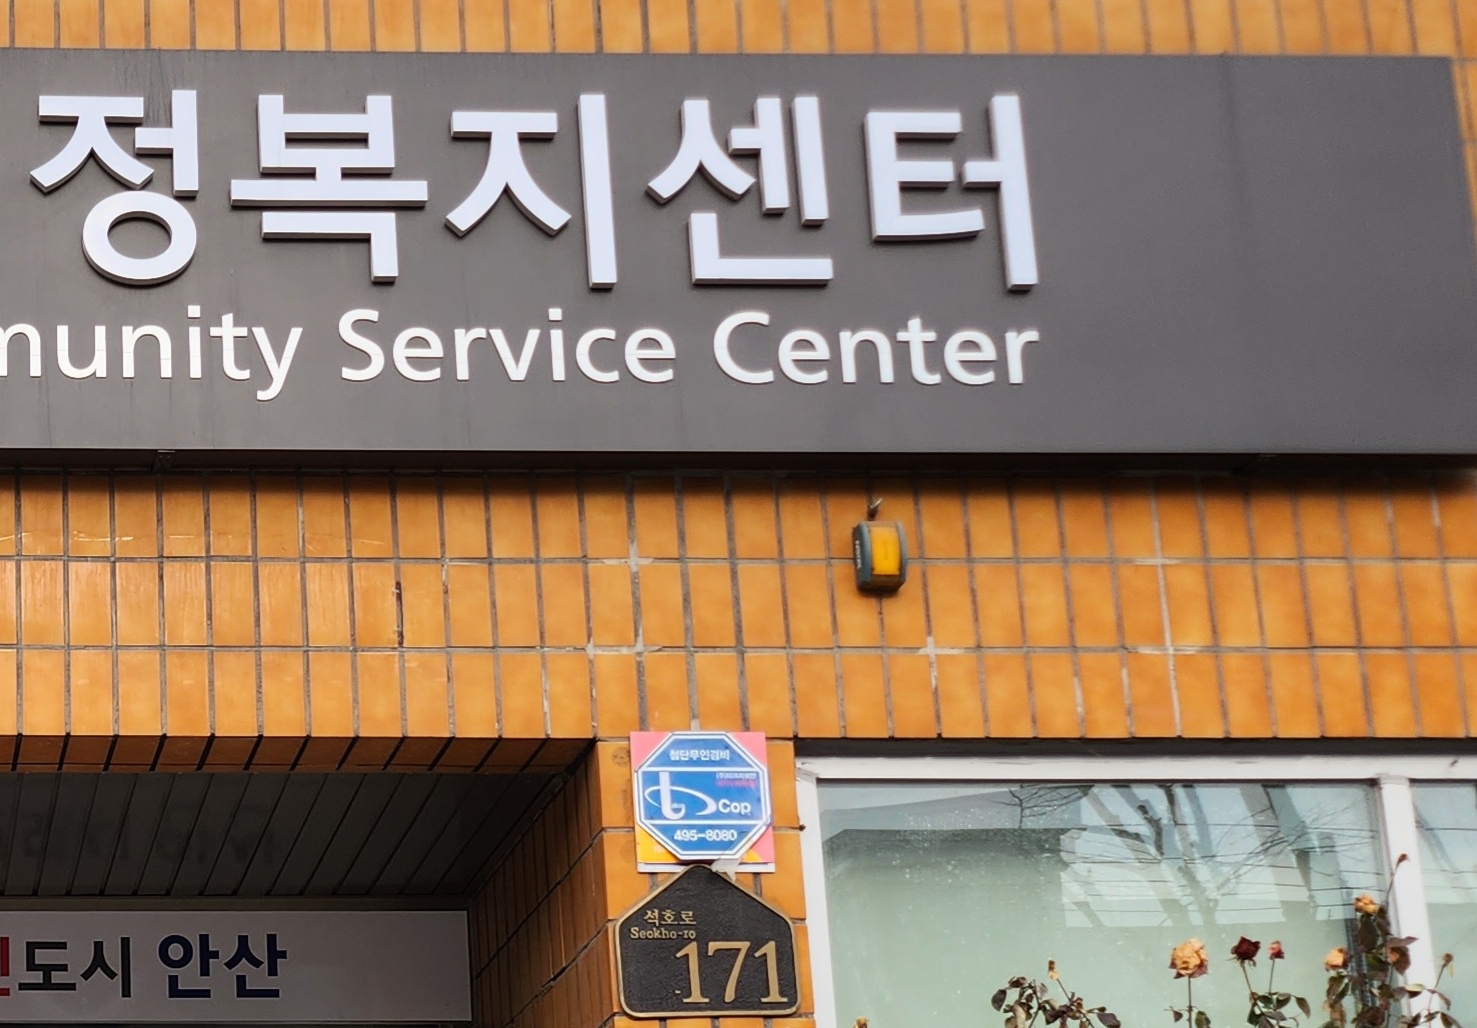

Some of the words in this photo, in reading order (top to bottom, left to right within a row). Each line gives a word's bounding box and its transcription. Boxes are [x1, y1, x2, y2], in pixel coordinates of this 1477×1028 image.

[340, 308, 676, 383] Service
[713, 310, 1039, 386] Center
[669, 749, 730, 761] 첨단무인경비
[718, 799, 751, 815] Cop
[673, 829, 737, 841] 495-8080
[643, 908, 697, 926] 석호로
[629, 927, 696, 939] Seokho-ro
[157, 932, 287, 999] 안산
[675, 940, 788, 1003] 171
